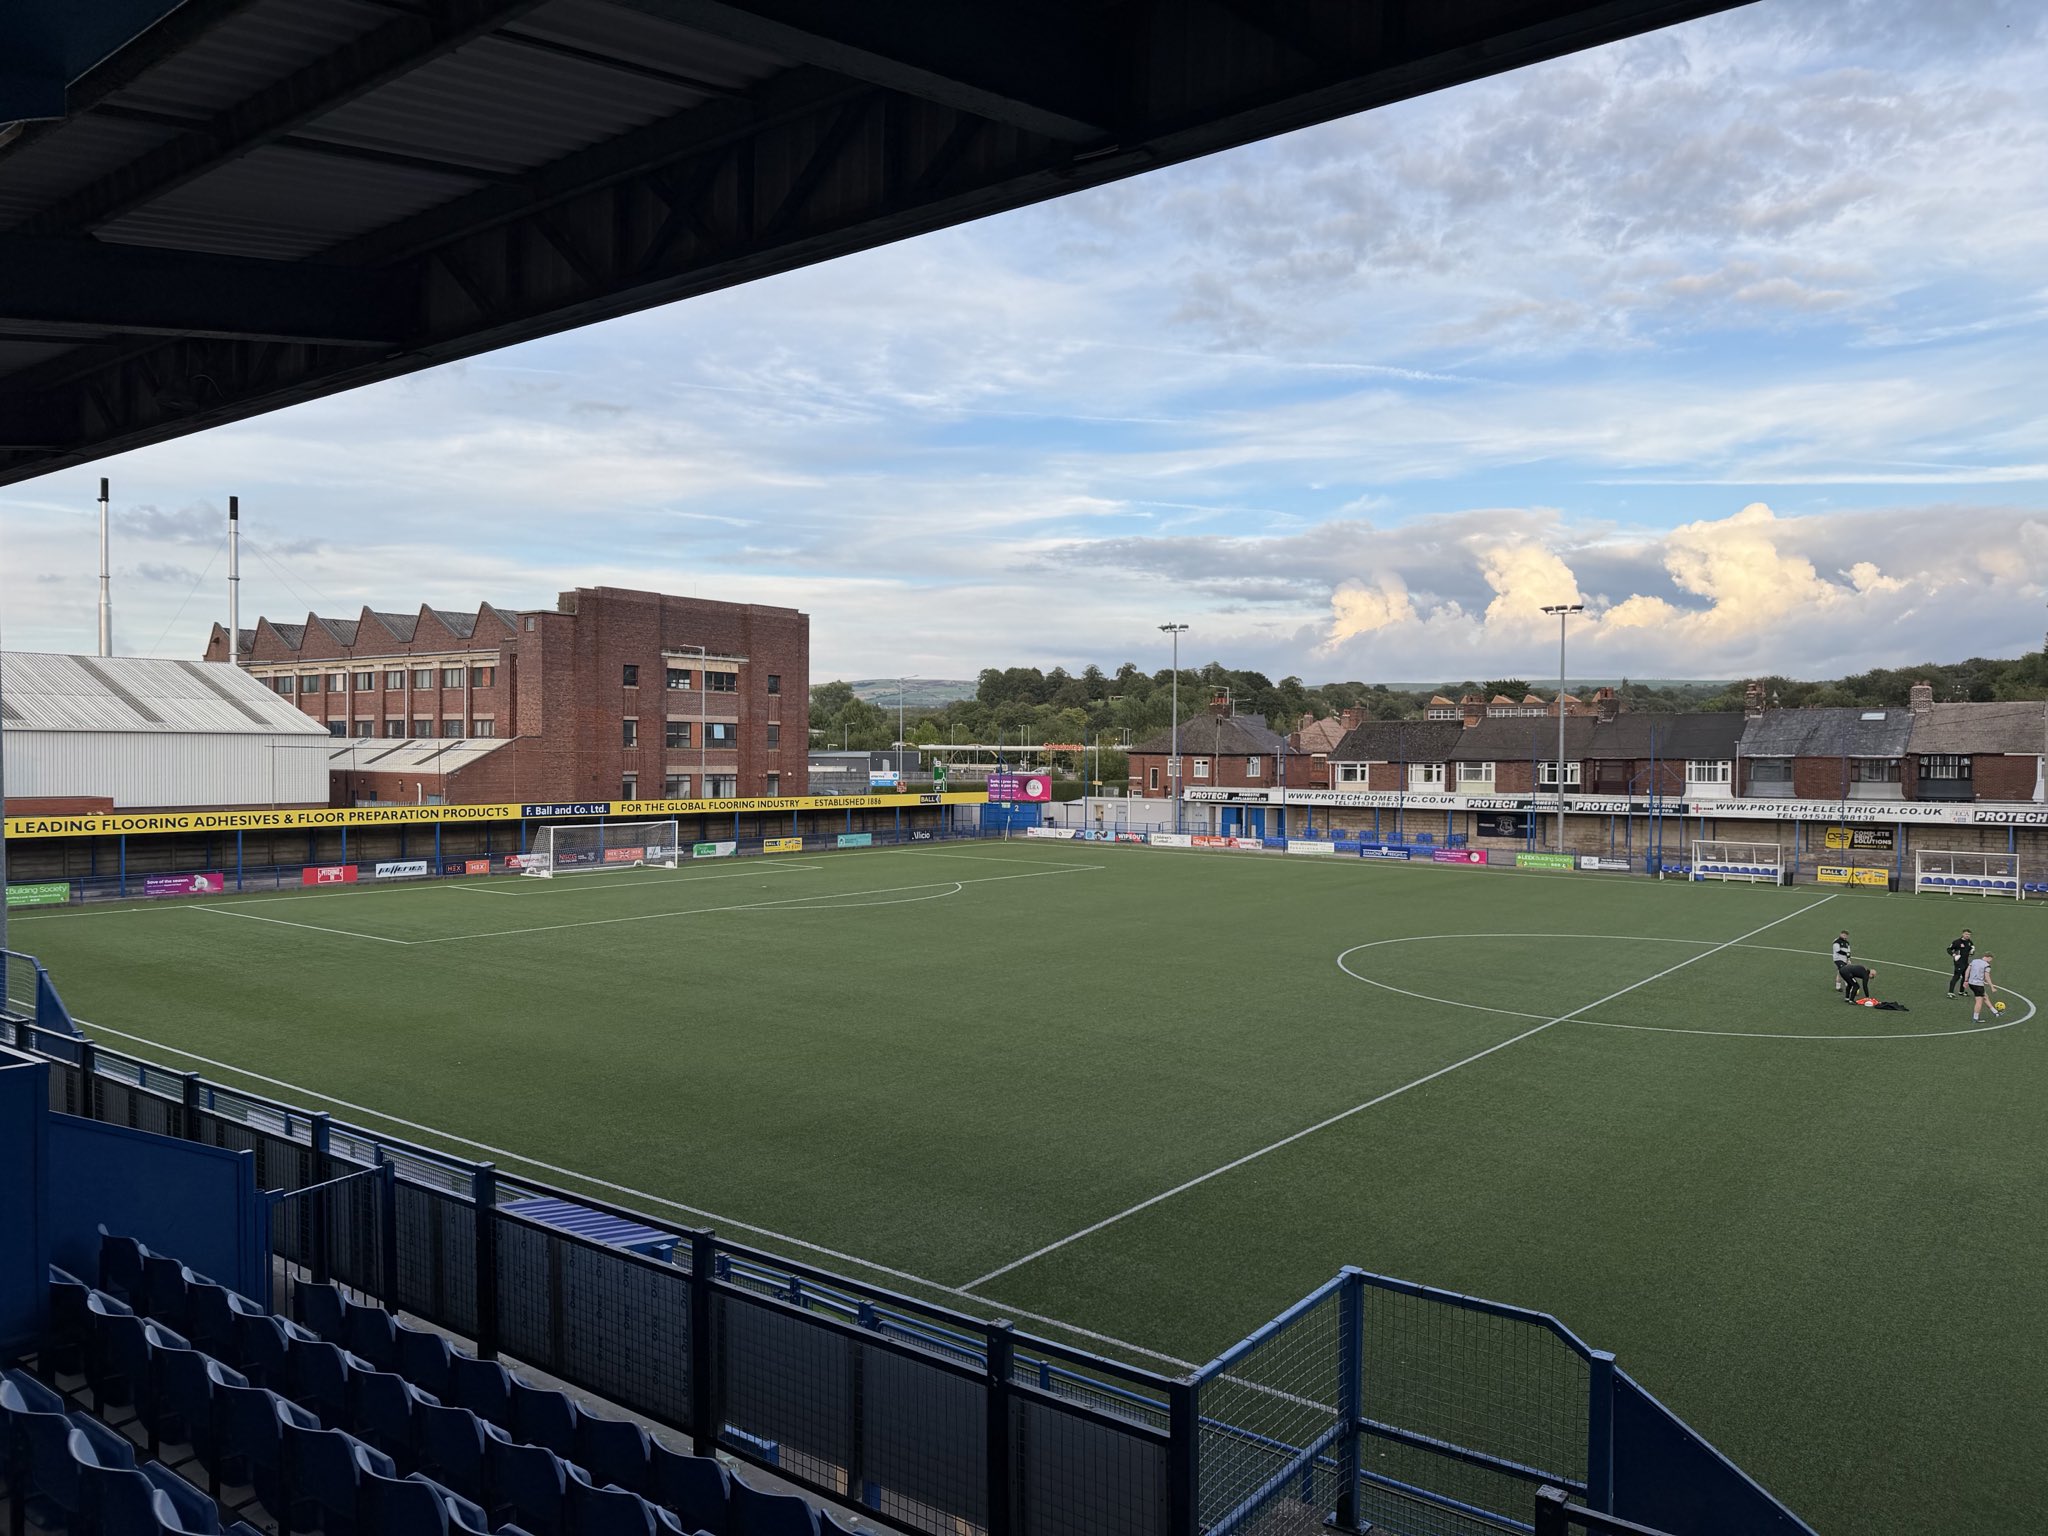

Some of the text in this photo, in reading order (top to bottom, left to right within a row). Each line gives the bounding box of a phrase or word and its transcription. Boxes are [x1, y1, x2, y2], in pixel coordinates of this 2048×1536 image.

[920, 795, 936, 803] BALL
[1190, 791, 1229, 800] PROTECH
[1288, 793, 1456, 804] WWW.PROTECH-DOMESTIC.CO.UK
[621, 804, 642, 812] FOR
[644, 803, 665, 811] THE
[667, 802, 706, 811] GLOBAL
[708, 801, 755, 810] FLOORING
[757, 799, 800, 808] INDUSTRY
[814, 798, 866, 807] ESTABLISHED
[1467, 799, 1518, 809] PROTECH
[1575, 802, 1631, 811] PROTECH
[536, 807, 552, 815] Ball
[554, 806, 572, 814] and
[575, 805, 589, 814] Co.
[590, 805, 607, 813] Ltd.
[1716, 804, 1943, 815] WWW.PROTECH-ELECTRICAL.CO.UK
[15, 821, 96, 834] LEADING
[102, 817, 189, 831] FLOORING
[194, 814, 280, 828] ADHESIVES
[284, 814, 294, 824] &
[298, 812, 345, 824] FLOOR
[349, 809, 440, 822] PREPARATION
[443, 807, 509, 819] PRODUCTS
[1975, 811, 2048, 823] PROTECH
[9, 887, 38, 895] Building
[39, 885, 67, 894] Society
